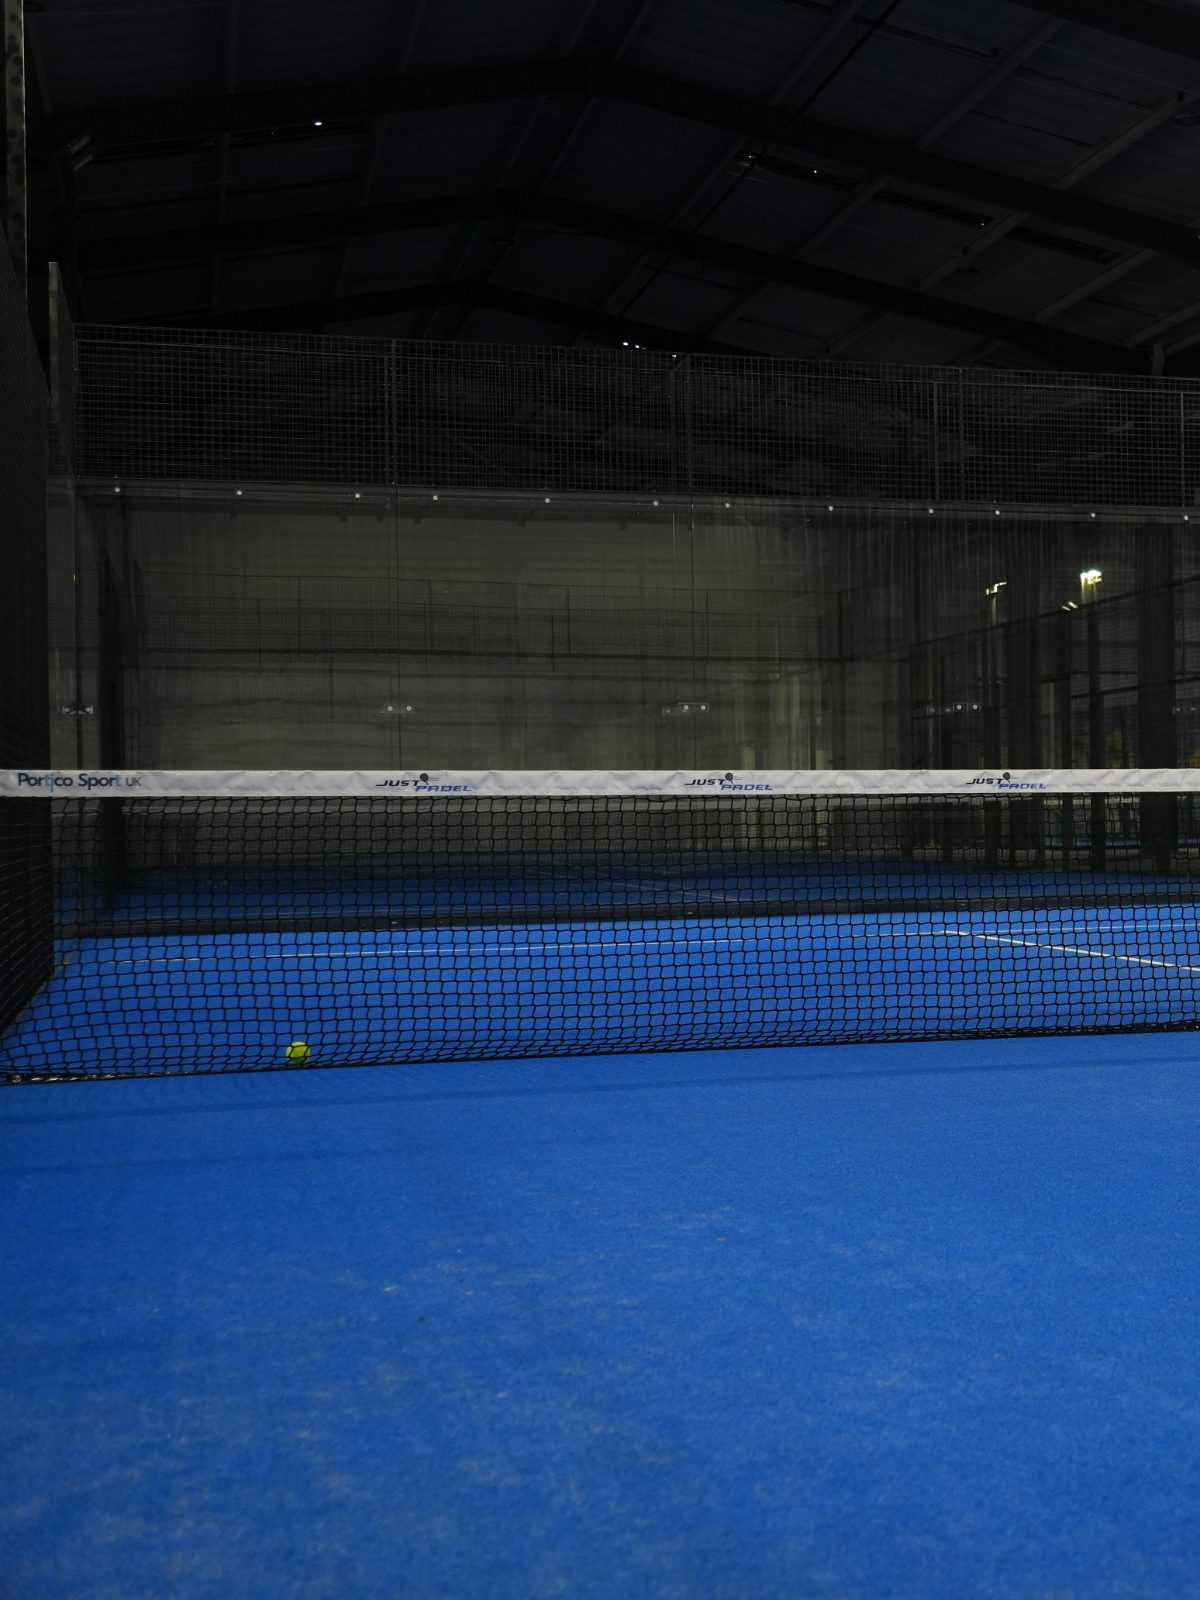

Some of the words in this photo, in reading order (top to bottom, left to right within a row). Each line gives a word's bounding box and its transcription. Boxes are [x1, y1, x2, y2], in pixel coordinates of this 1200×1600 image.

[18, 773, 73, 792] Portico
[78, 773, 122, 790] Sport
[126, 777, 142, 787] UK
